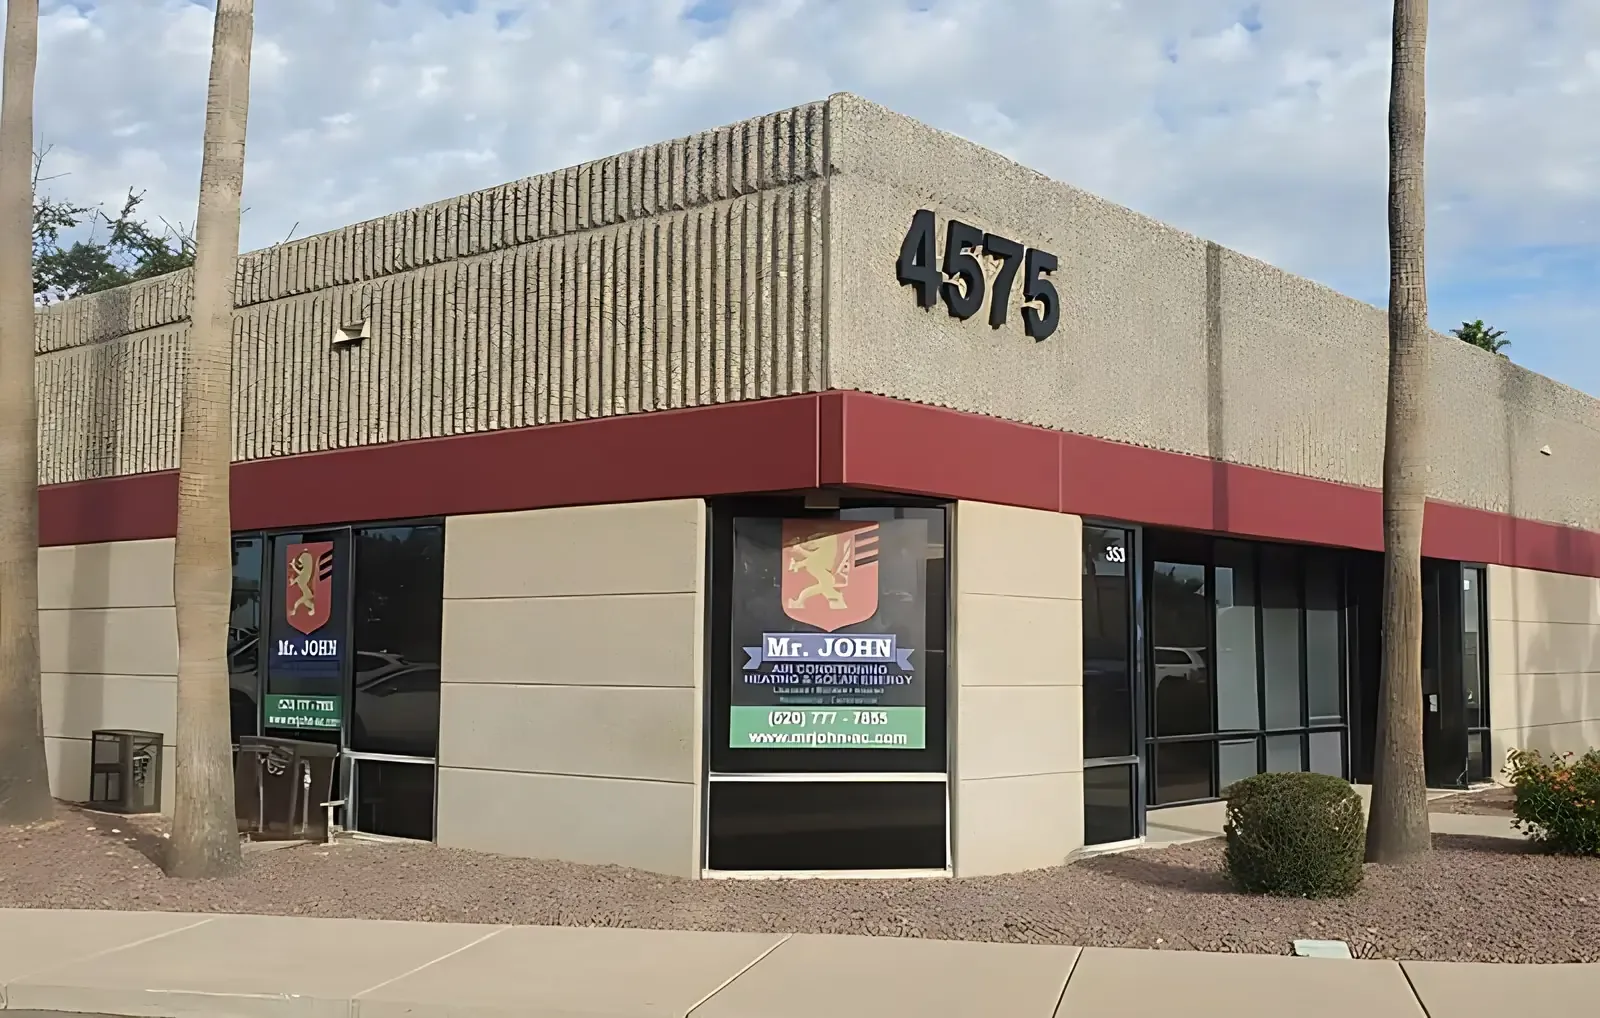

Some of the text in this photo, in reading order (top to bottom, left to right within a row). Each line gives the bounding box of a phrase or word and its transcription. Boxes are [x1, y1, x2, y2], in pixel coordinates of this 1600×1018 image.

[896, 209, 1060, 342] 4575
[301, 640, 337, 656] JOHN
[767, 637, 891, 658] Mr. JOHN
[811, 711, 837, 724] 777
